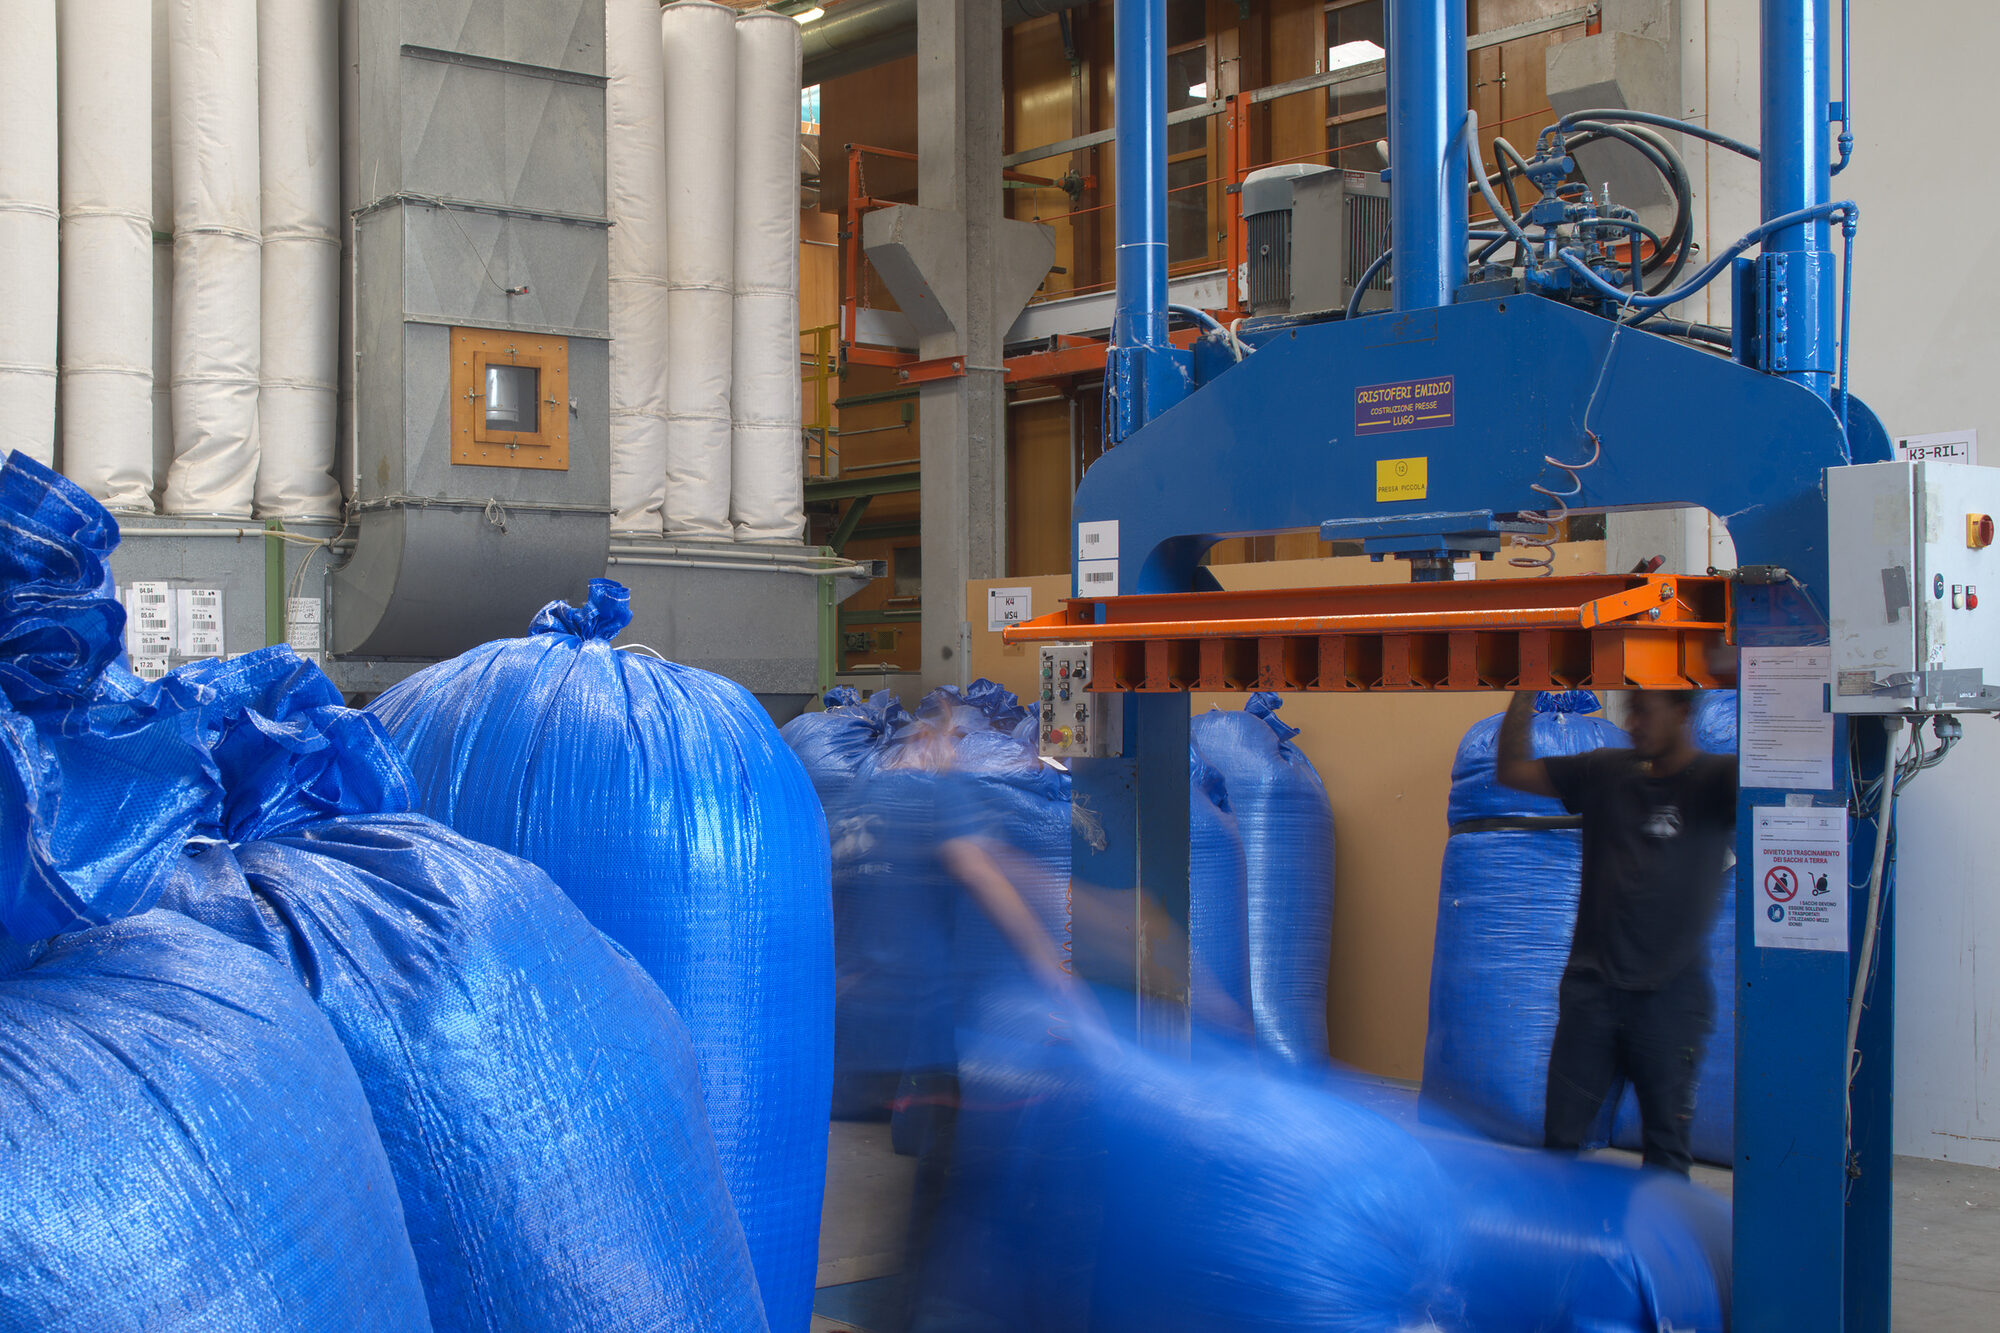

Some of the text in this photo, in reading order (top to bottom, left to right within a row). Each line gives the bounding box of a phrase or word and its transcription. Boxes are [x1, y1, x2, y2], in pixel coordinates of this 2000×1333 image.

[1358, 381, 1451, 404] CRISTOFERI EMIDIO
[1370, 401, 1438, 415] COSTRUZIONE PRESSE
[1393, 415, 1414, 426] LUGO
[1006, 597, 1015, 606] K4
[1004, 611, 1018, 620] WS4
